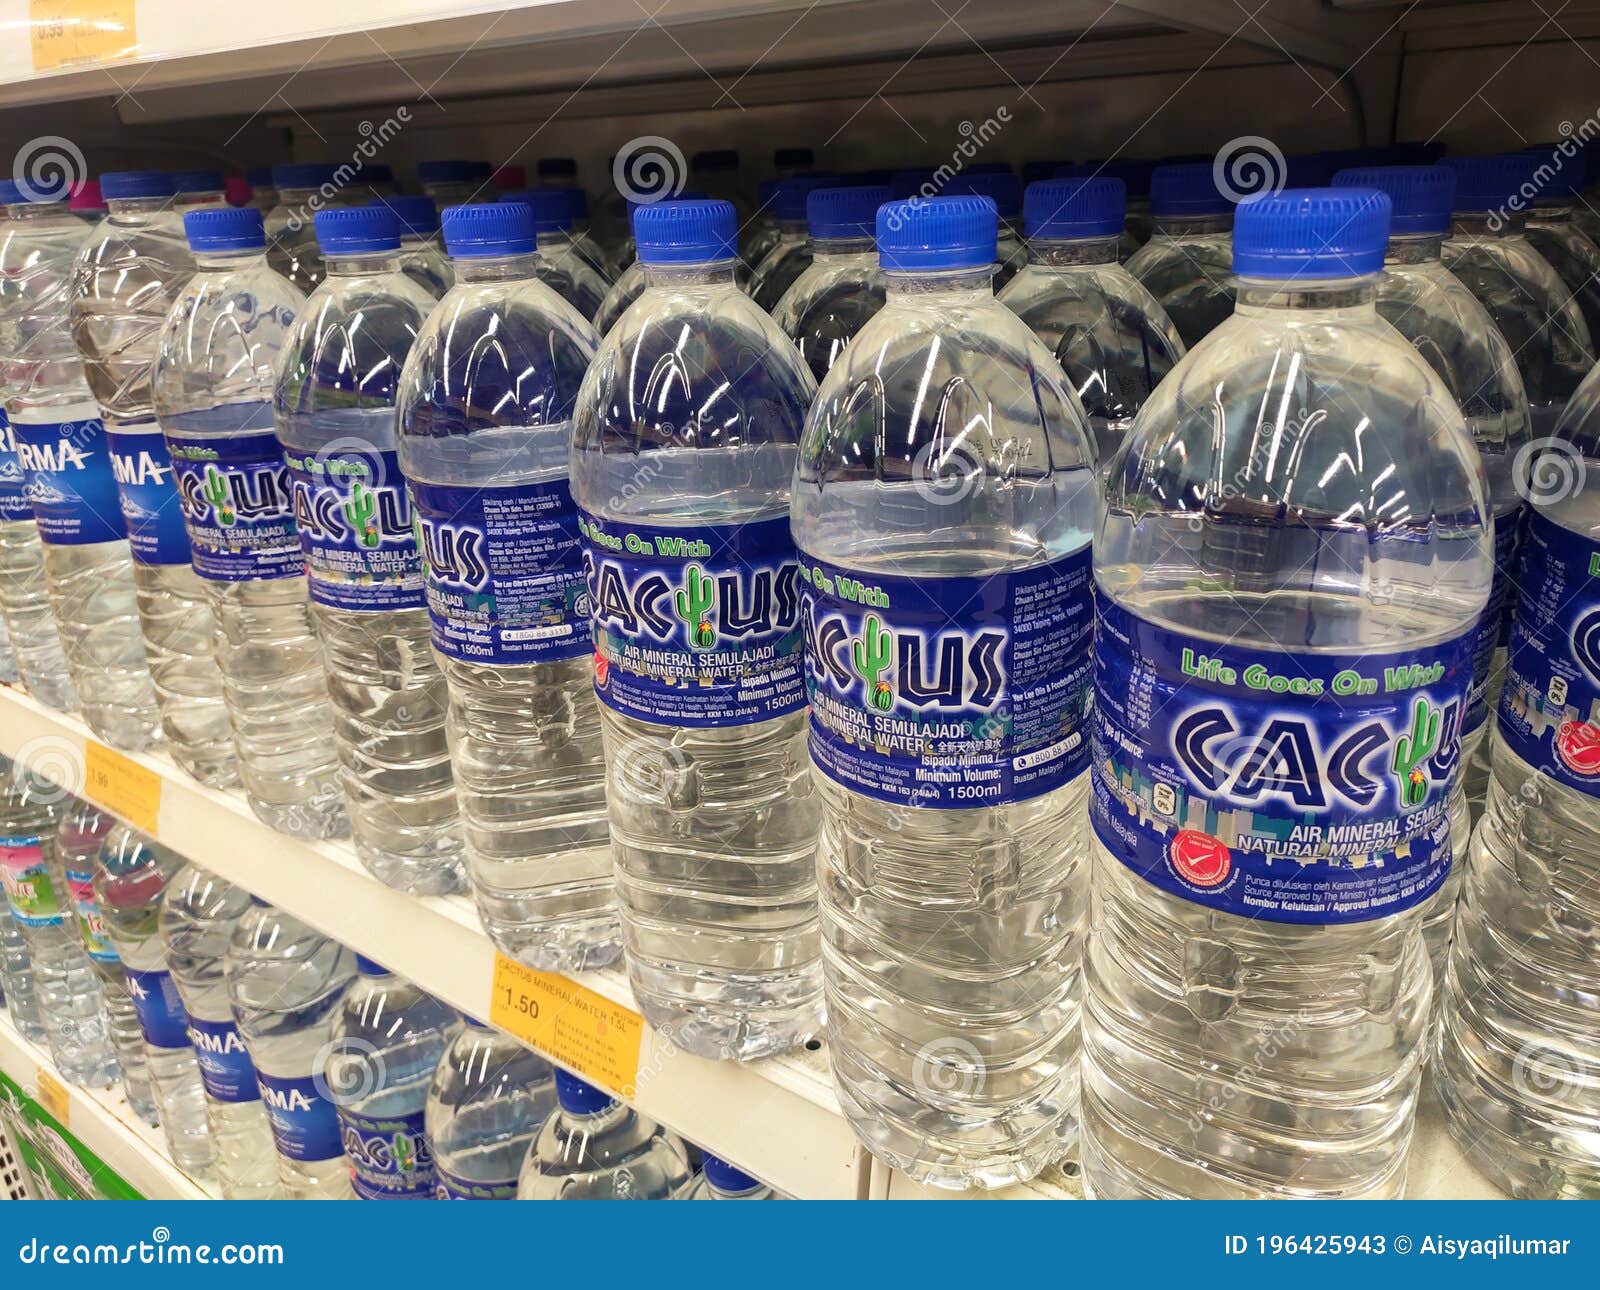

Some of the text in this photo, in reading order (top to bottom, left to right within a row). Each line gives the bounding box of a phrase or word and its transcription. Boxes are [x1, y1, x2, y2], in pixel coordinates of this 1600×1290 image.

[625, 534, 653, 555] On
[655, 536, 711, 557] With
[280, 561, 306, 572] 1500
[371, 561, 405, 573] WATER
[813, 567, 834, 595] On
[835, 574, 889, 608] With
[1013, 621, 1032, 634] 34000
[461, 644, 494, 657] 1500ml
[624, 644, 640, 659] AIR
[642, 649, 696, 667] MINERAL
[699, 645, 775, 667] SEMULAJADI
[800, 592, 1007, 713] ACTUS
[646, 663, 698, 679] MINERAL
[702, 664, 744, 679] WATER
[741, 665, 796, 688] Isipadu Minima
[1181, 647, 1445, 696] Life Goes On With
[737, 677, 802, 702] Minimum Volume:
[765, 688, 803, 711] 1500ml
[826, 697, 872, 729] MINERAL
[874, 716, 965, 739] SEMULAJADI
[829, 713, 875, 744] MINERAL
[878, 732, 925, 753] WATER
[921, 752, 994, 769] Isipadu Minima
[1030, 751, 1051, 765] 1800
[1172, 691, 1462, 811] CACTU
[915, 767, 1002, 783] Minimum Volume:
[1014, 761, 1064, 785] Buatan Malaysia
[948, 784, 1002, 800] 1500ml
[1110, 814, 1138, 847] Malaysia
[1289, 825, 1322, 844] AIR
[1327, 818, 1402, 843] MINERAL
[1237, 835, 1399, 858] NATURAL MINERAL
[1245, 874, 1271, 887] Punca
[1272, 879, 1312, 890] diluluskan
[1243, 894, 1279, 909] Nombor
[1281, 899, 1325, 913] Kelulusan
[1332, 898, 1369, 913] Approval
[1244, 885, 1272, 898] Source
[1273, 890, 1311, 902] approved
[1312, 892, 1322, 903] by
[1324, 891, 1338, 901] The
[1340, 890, 1367, 902] Ministry
[1368, 886, 1377, 897] Of
[498, 959, 532, 985] CACTUS
[533, 977, 572, 1006] MINERAL
[573, 992, 608, 1021] WATER
[505, 987, 540, 1020] 1.50
